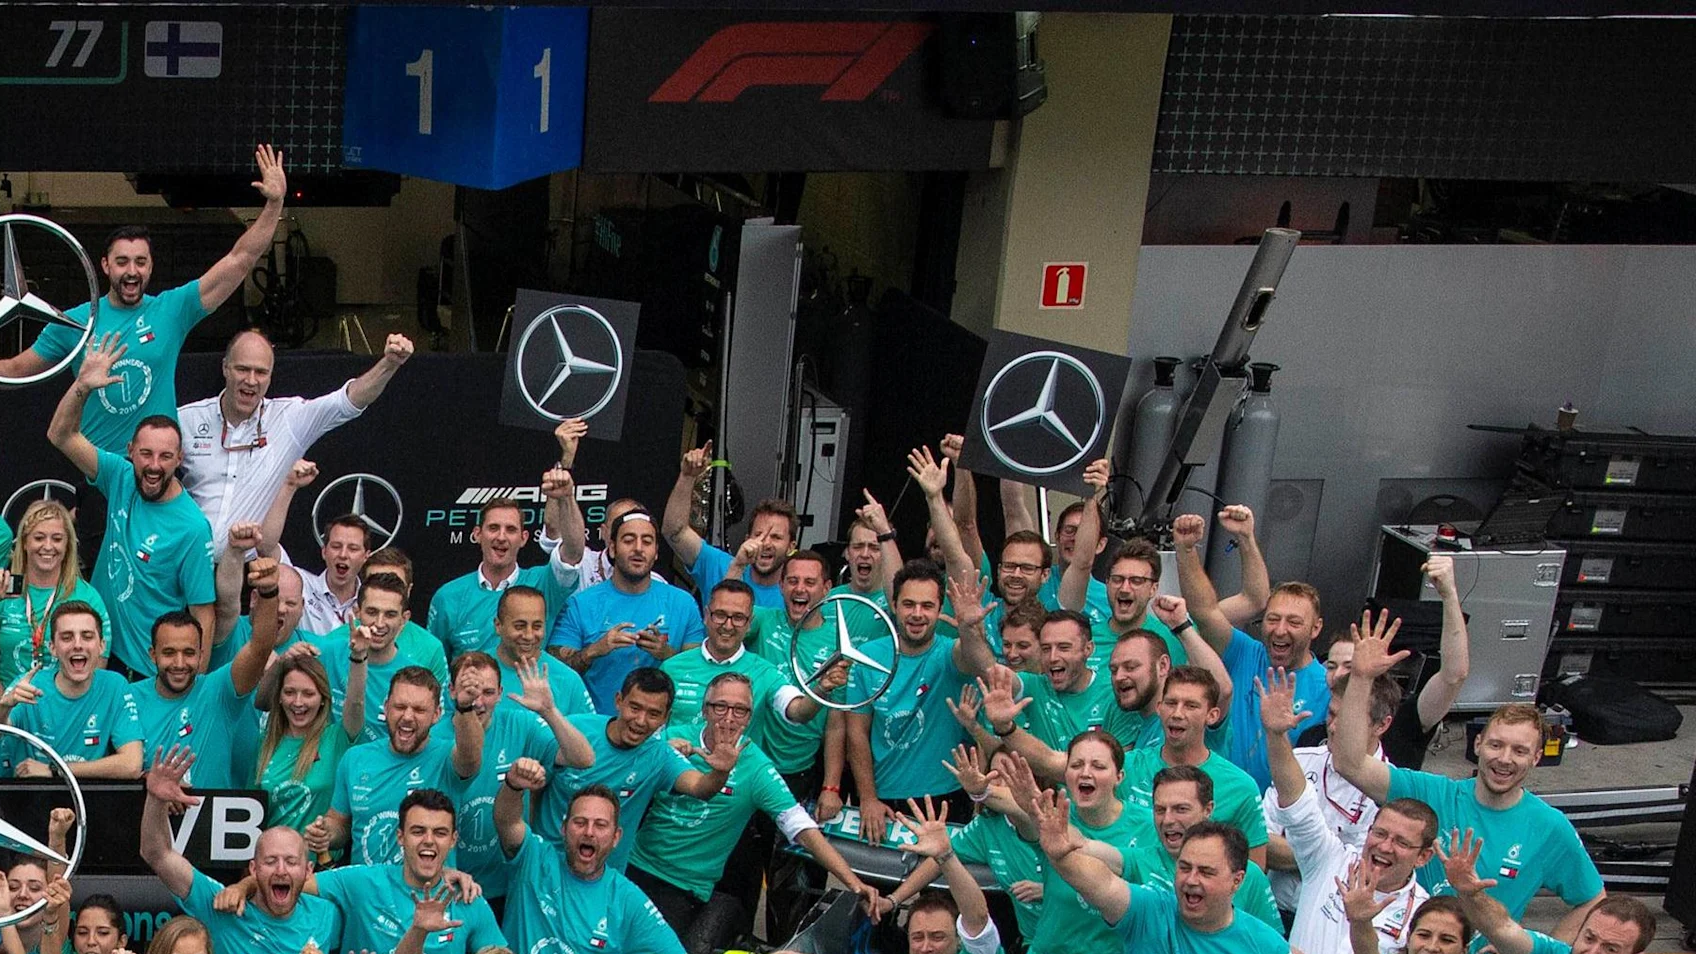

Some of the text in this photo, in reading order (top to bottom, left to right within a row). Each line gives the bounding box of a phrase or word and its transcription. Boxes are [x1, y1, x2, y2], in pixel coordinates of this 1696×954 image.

[45, 20, 104, 68] 77
[406, 49, 433, 135] 1
[533, 47, 551, 133] 1
[469, 796, 495, 809] WINNE
[473, 807, 485, 841] 1
